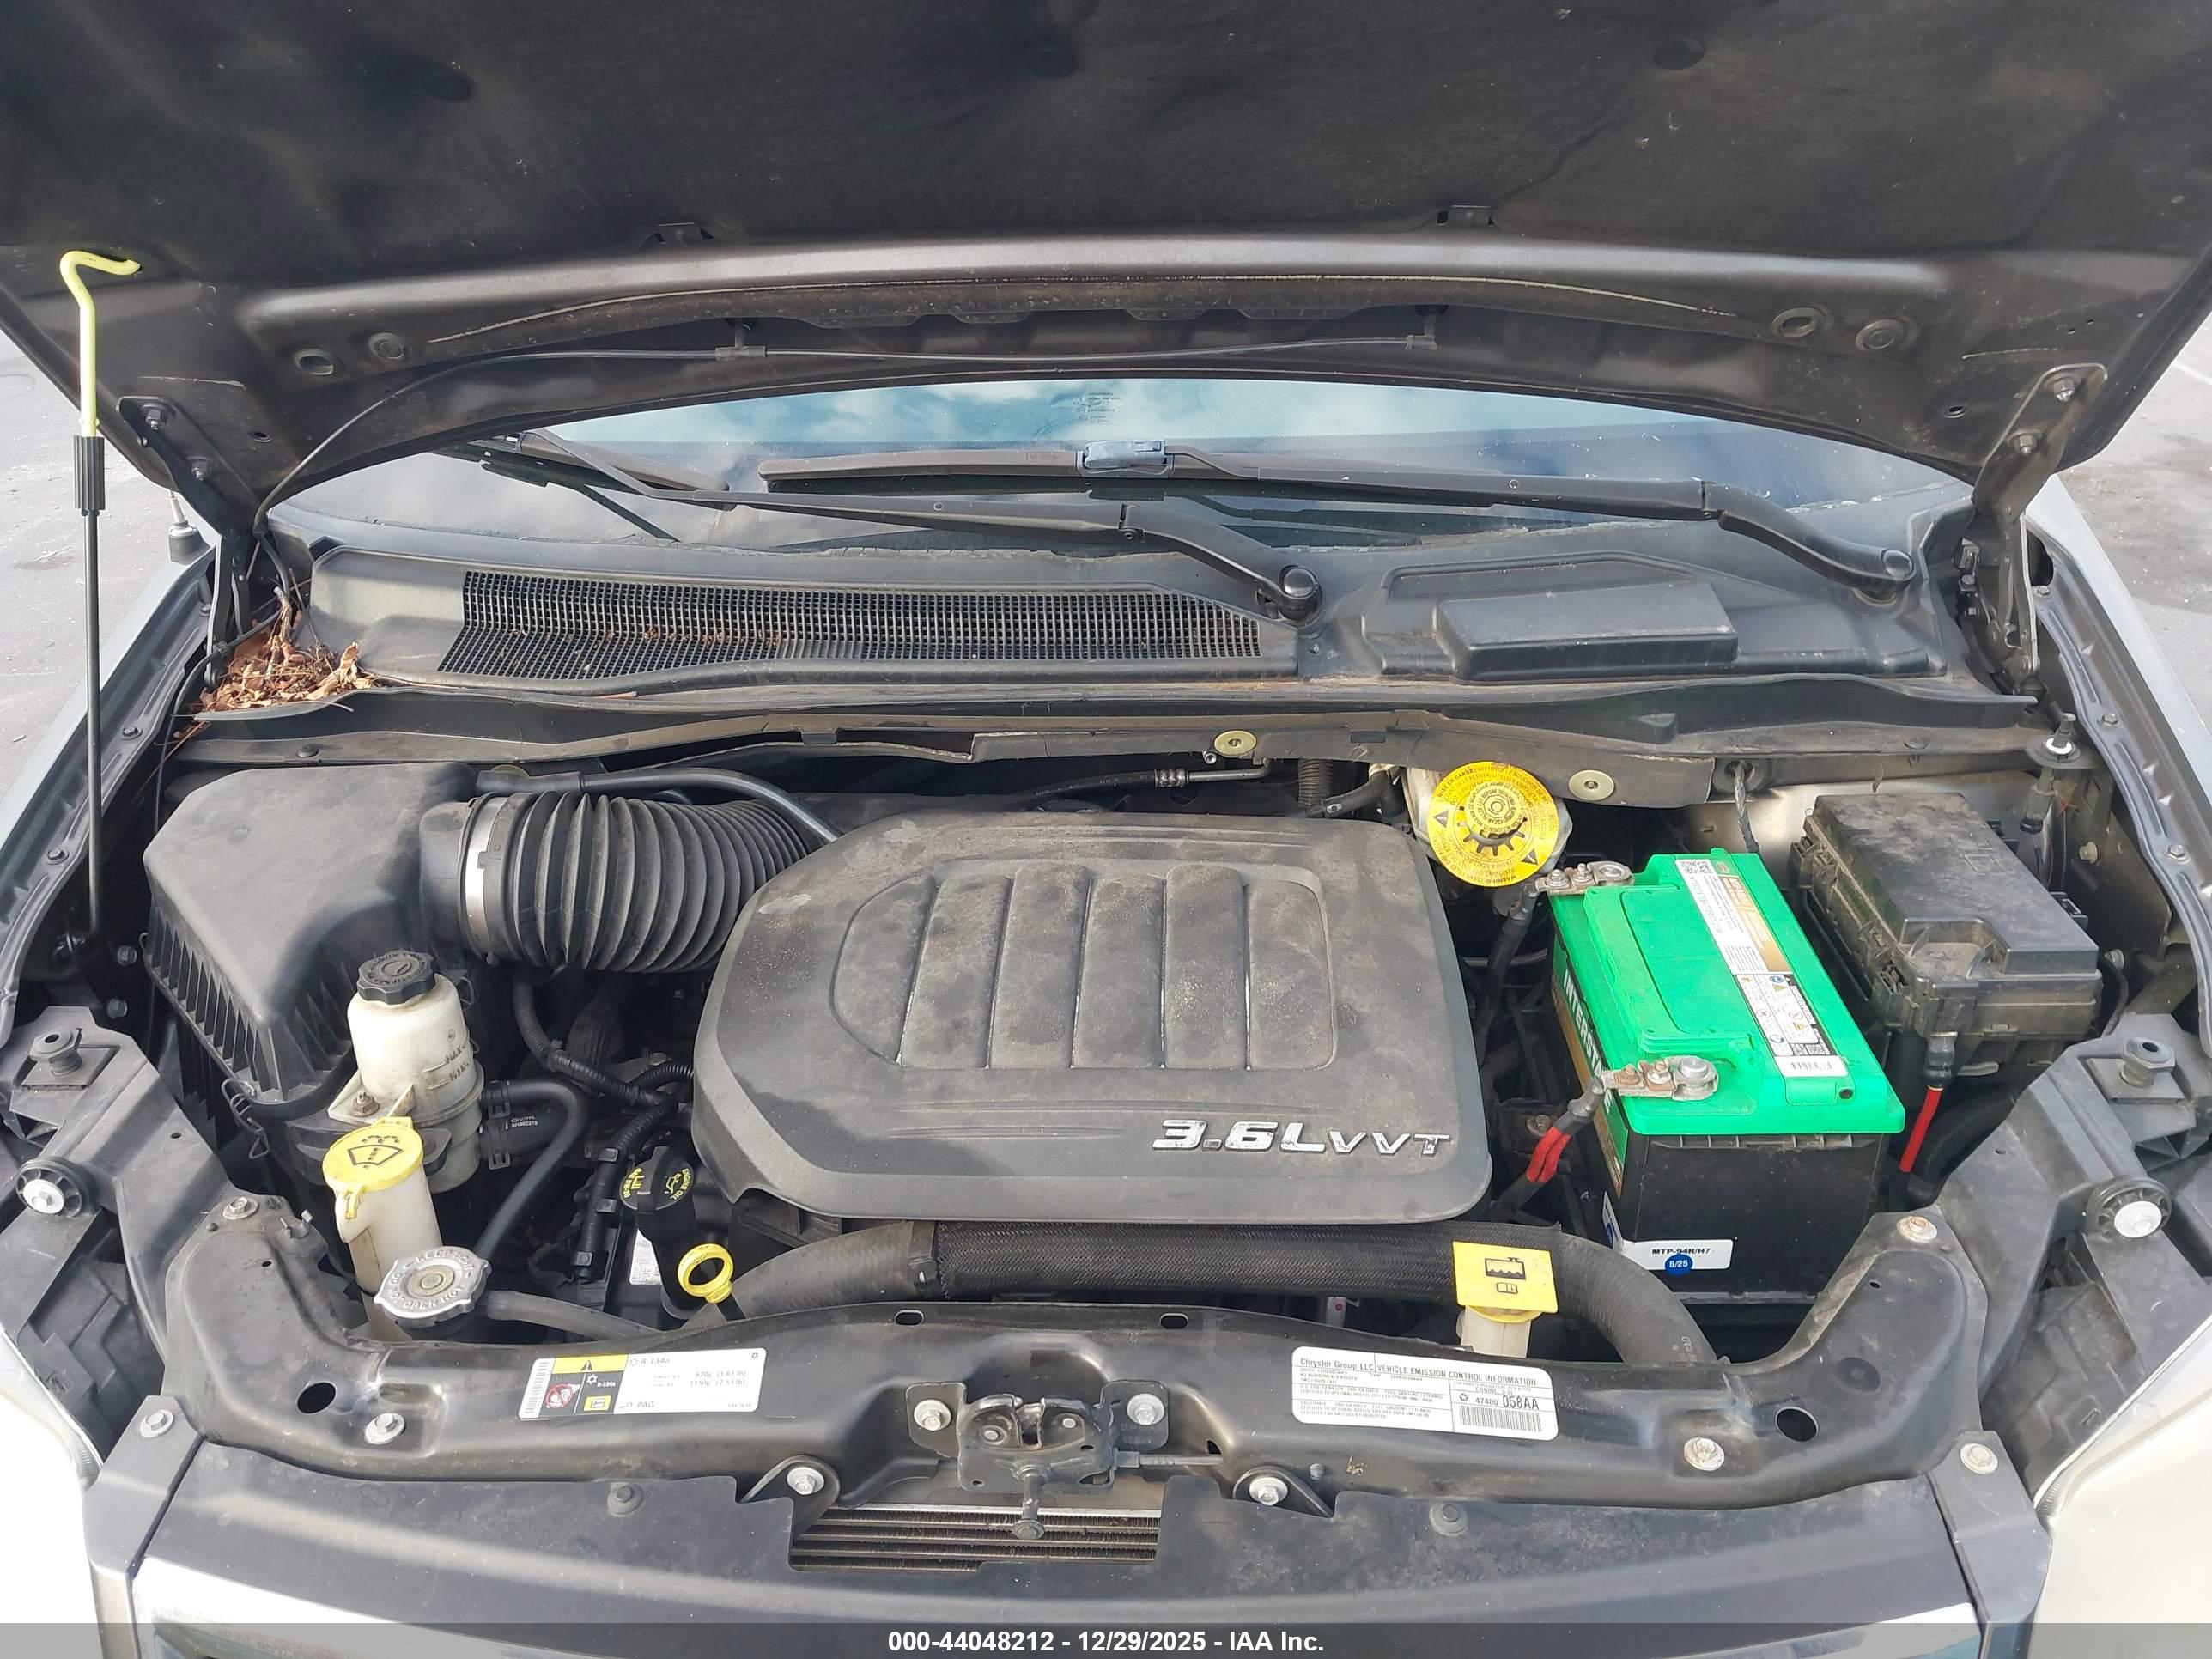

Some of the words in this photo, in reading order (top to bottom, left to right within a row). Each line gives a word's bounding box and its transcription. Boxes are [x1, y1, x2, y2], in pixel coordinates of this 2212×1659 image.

[1563, 968, 1613, 1115] INTERSTAE
[680, 1168, 690, 1190] ENGINE
[670, 1190, 684, 1200] OIL
[404, 1299, 438, 1310] OPEN
[1300, 1358, 1331, 1368] Chrysler
[1334, 1360, 1357, 1370] Group
[1359, 1362, 1374, 1370] LLC
[1376, 1364, 1407, 1374] VEHICLE
[1411, 1368, 1446, 1377] EMISSION
[1449, 1370, 1482, 1381] CONTROL
[1485, 1375, 1536, 1386] INFORMATION
[1502, 1395, 1539, 1410] 058AA
